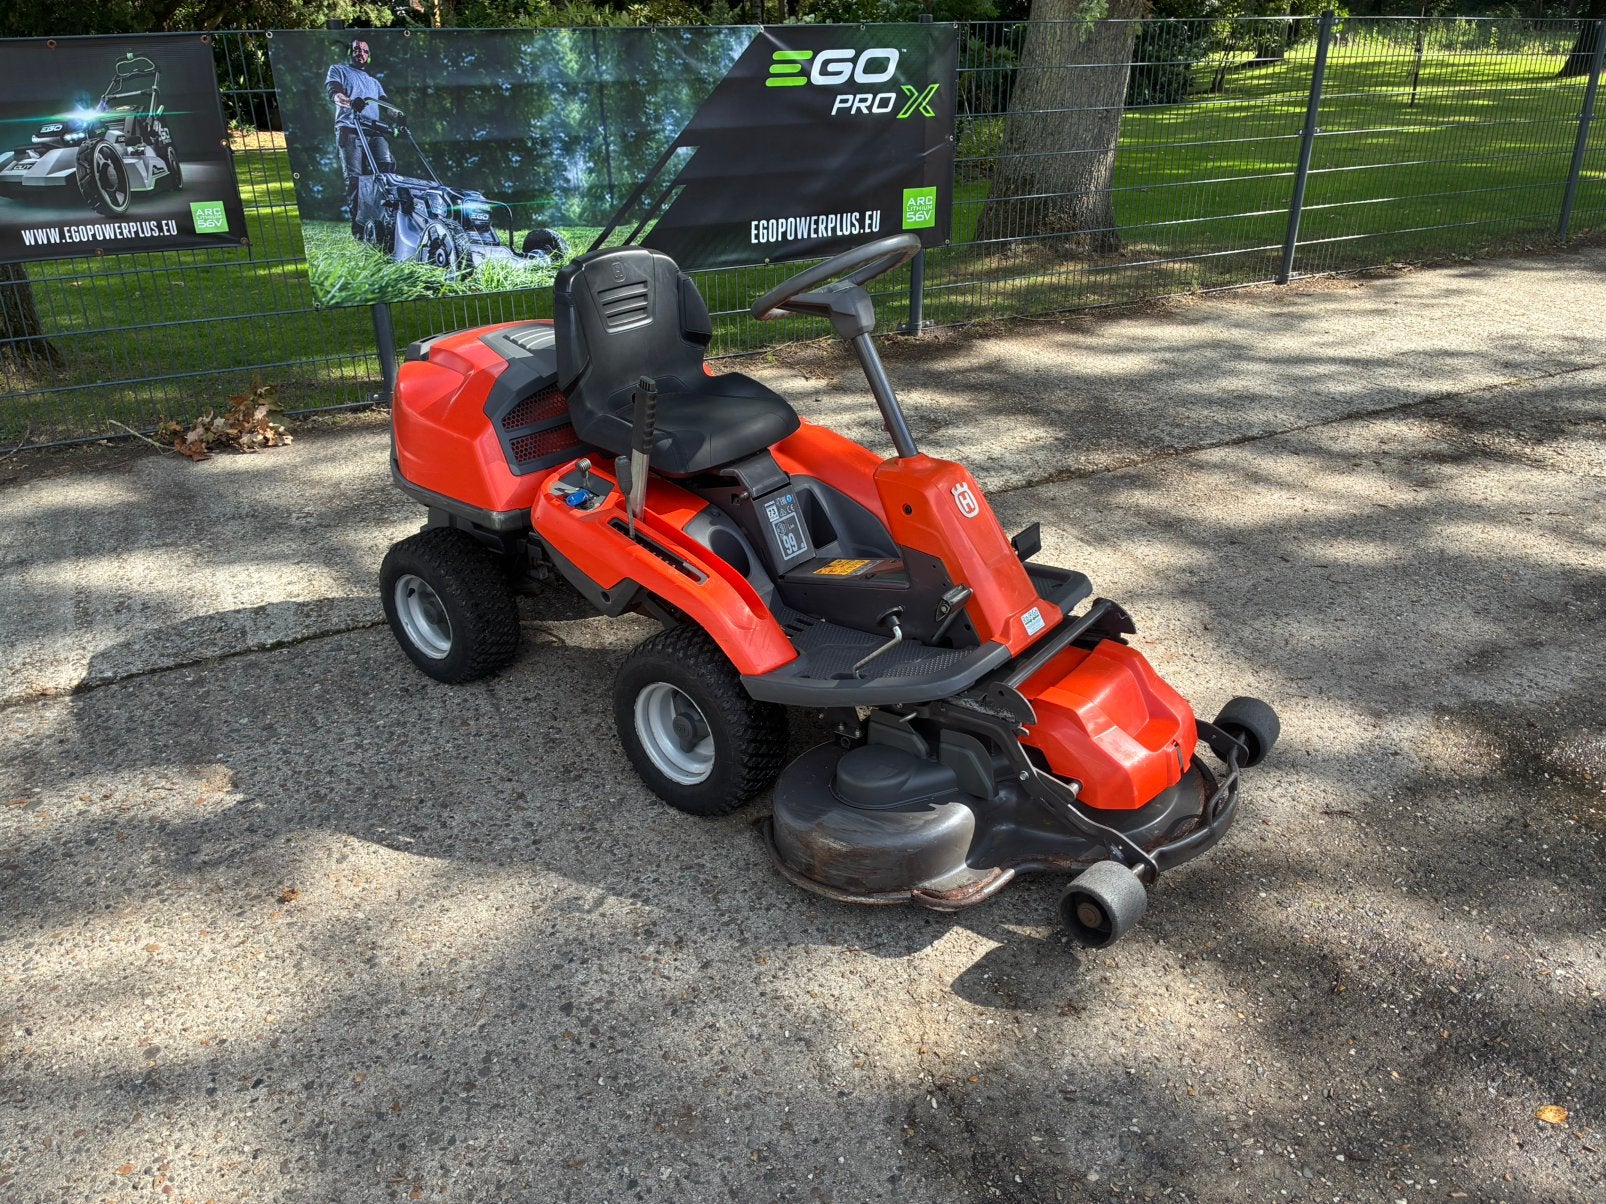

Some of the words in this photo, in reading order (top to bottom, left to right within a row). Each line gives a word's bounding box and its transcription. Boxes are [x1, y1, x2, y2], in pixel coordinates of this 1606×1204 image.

[765, 47, 900, 87] EGO
[831, 92, 897, 116] PRO
[896, 83, 940, 119] X
[40, 124, 63, 133] EGO
[907, 195, 933, 207] ARC
[196, 208, 222, 216] ARC
[470, 212, 489, 220] EGO
[906, 210, 932, 222] 56V
[197, 219, 223, 228] 56V
[751, 210, 881, 244] EGOPOWERPLUS.EU
[21, 220, 178, 246] WWW.EGOPOWERPLUS.EU
[782, 533, 798, 555] 99
